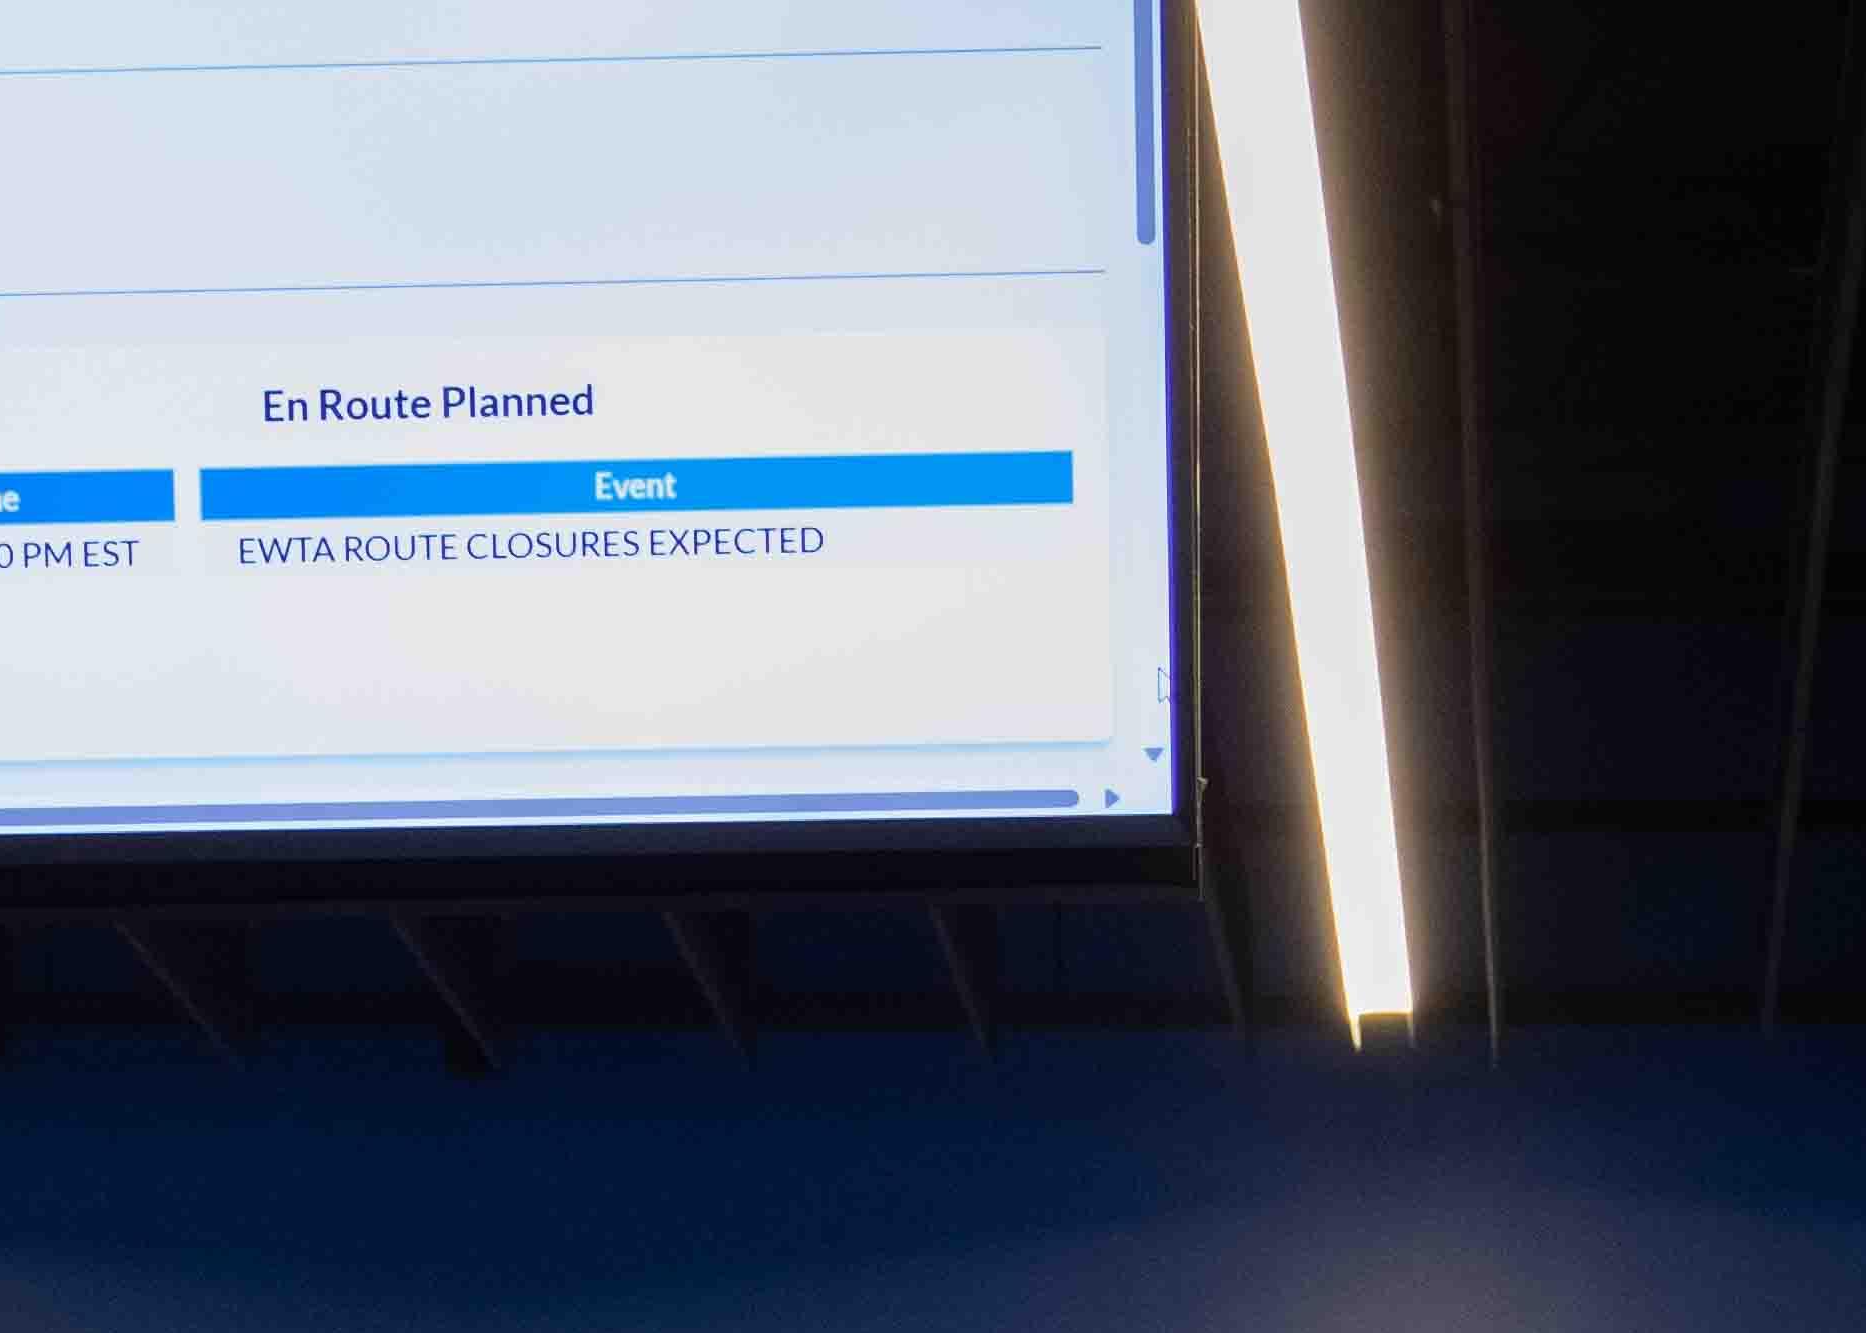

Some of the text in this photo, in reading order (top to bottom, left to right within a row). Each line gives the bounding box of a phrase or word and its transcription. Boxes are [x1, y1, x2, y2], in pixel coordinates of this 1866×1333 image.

[263, 384, 594, 423] En Route Planned
[595, 472, 676, 500] Event
[22, 542, 74, 569] PM
[82, 539, 140, 567] EST
[239, 526, 824, 565] EWTA ROUTE CLOSURES EXPECTED
